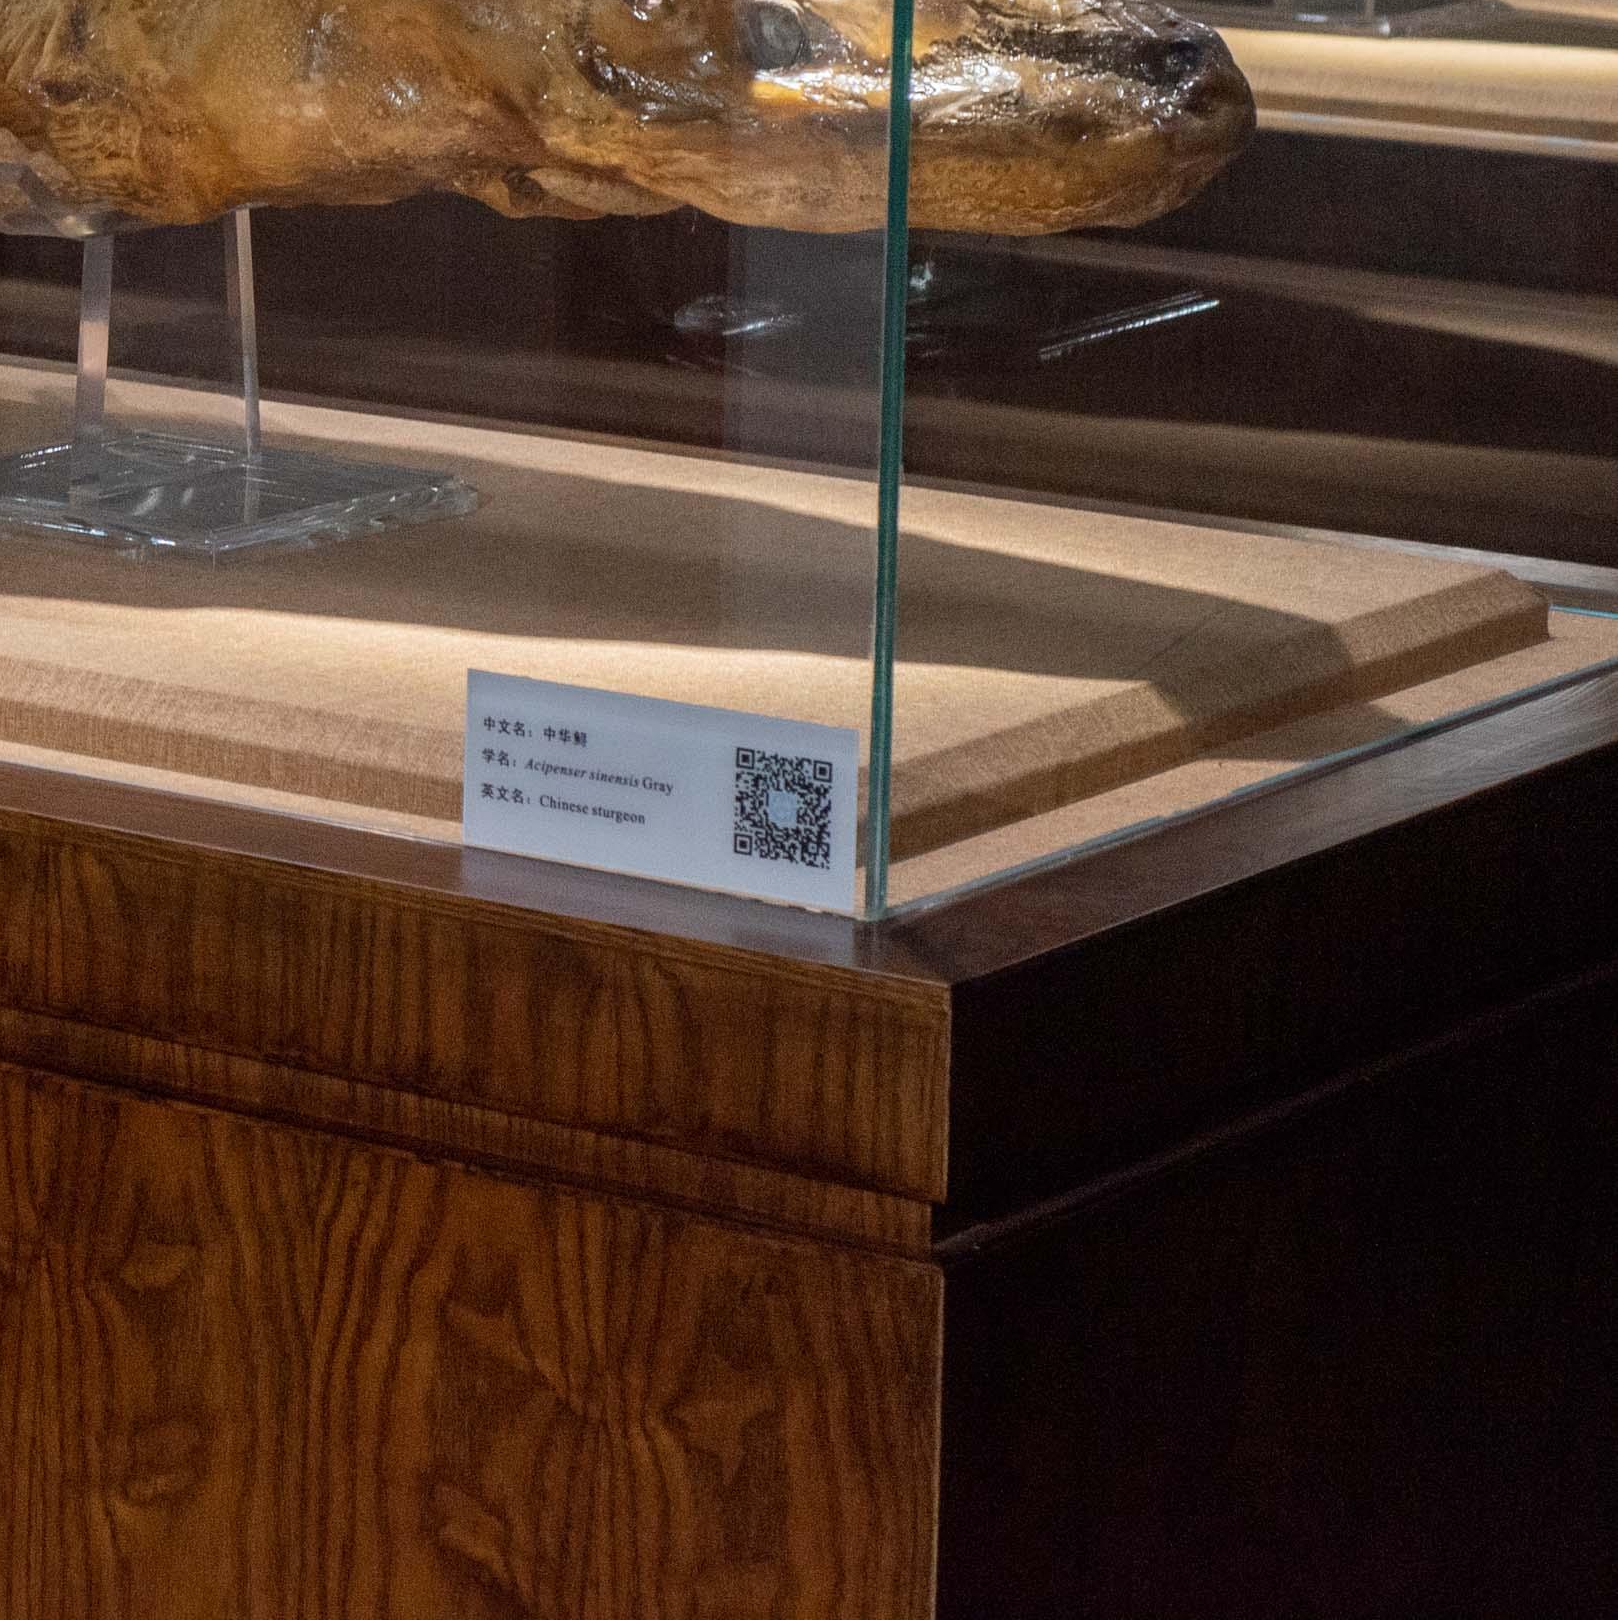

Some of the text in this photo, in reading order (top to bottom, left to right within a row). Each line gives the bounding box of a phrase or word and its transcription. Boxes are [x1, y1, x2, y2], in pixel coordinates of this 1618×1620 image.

[525, 758, 587, 779] Acipenser
[589, 770, 640, 788] sinensis
[642, 776, 674, 796] Gray
[539, 795, 589, 815] Chinese
[591, 803, 646, 825] sturgeon
